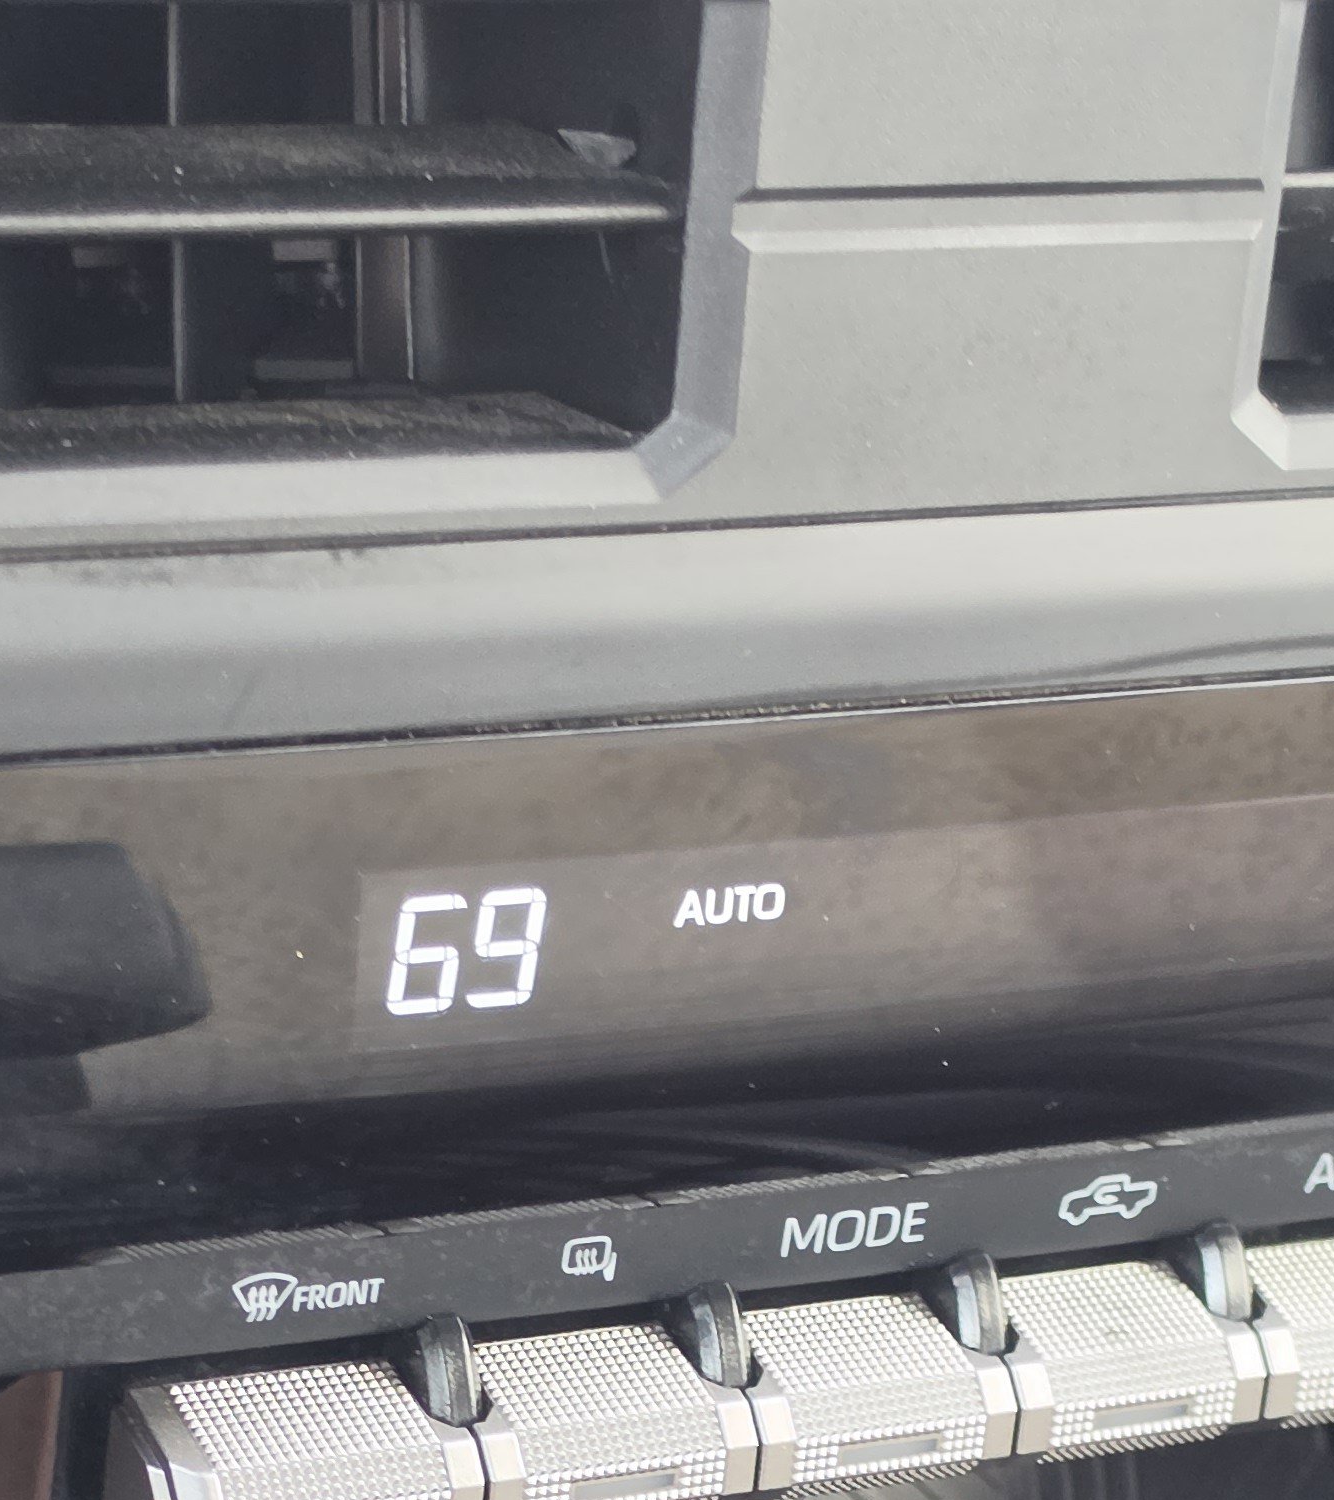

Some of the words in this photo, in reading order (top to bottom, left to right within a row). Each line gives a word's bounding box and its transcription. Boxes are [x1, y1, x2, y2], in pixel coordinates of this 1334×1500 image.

[673, 882, 786, 929] AUTO
[385, 885, 549, 1016] 69
[779, 1201, 930, 1259] MODE
[291, 1276, 386, 1313] FRONT
